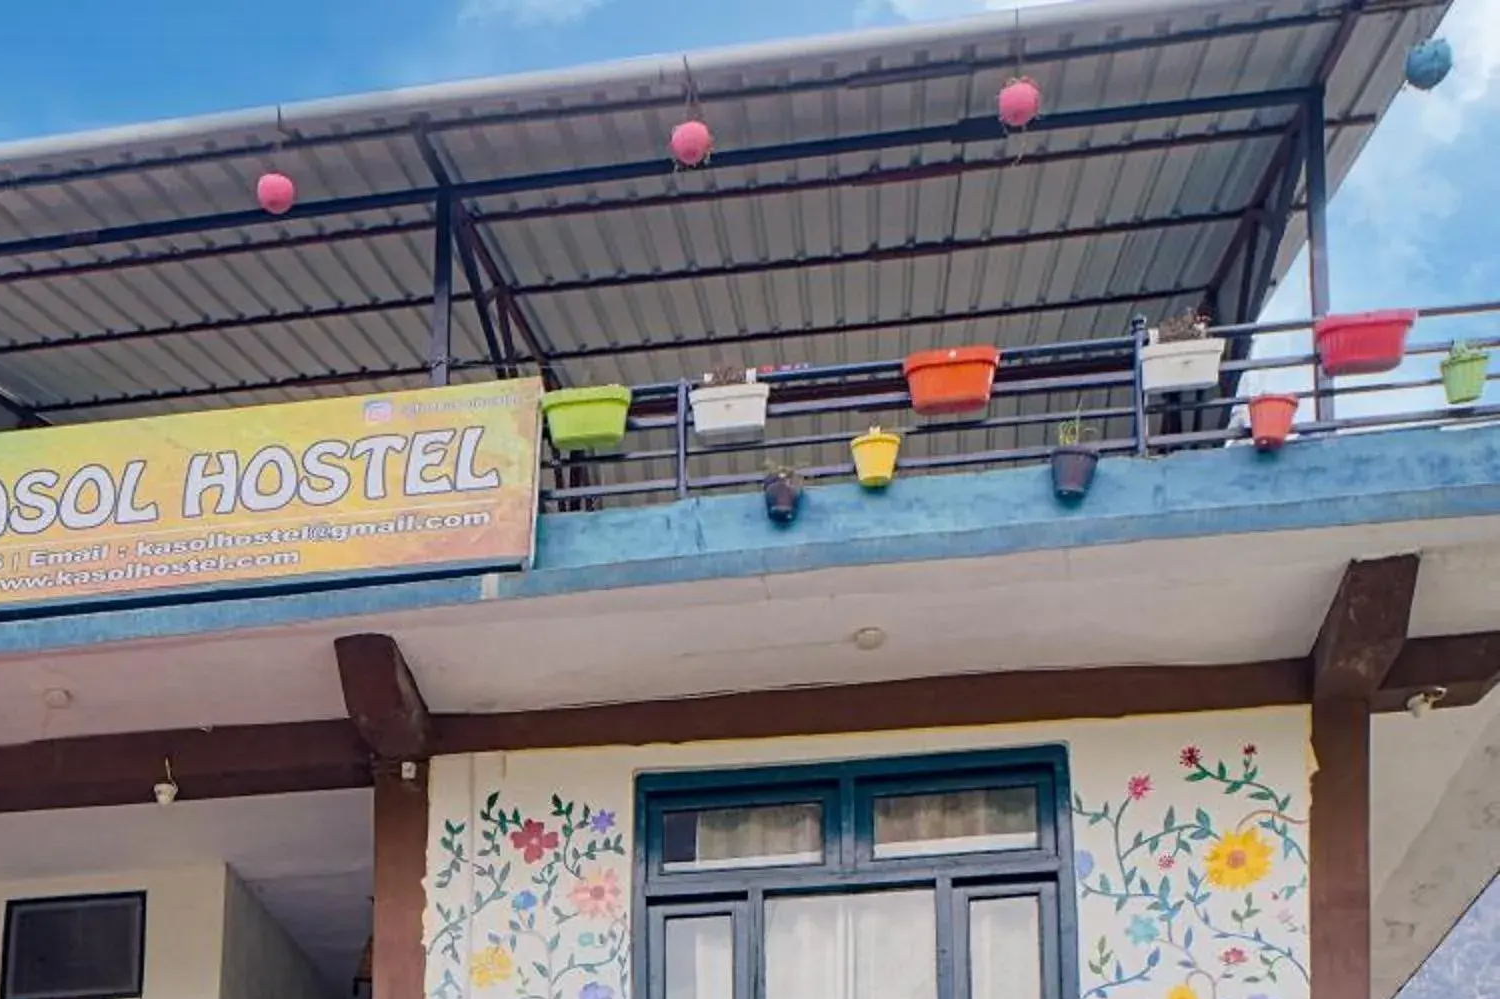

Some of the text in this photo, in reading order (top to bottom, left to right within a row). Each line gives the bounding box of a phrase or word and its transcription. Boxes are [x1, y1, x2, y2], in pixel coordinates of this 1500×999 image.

[181, 425, 500, 518] HOSTEL
[29, 546, 109, 568] Email
[136, 510, 491, 557] kasolhostel@gmail.com
